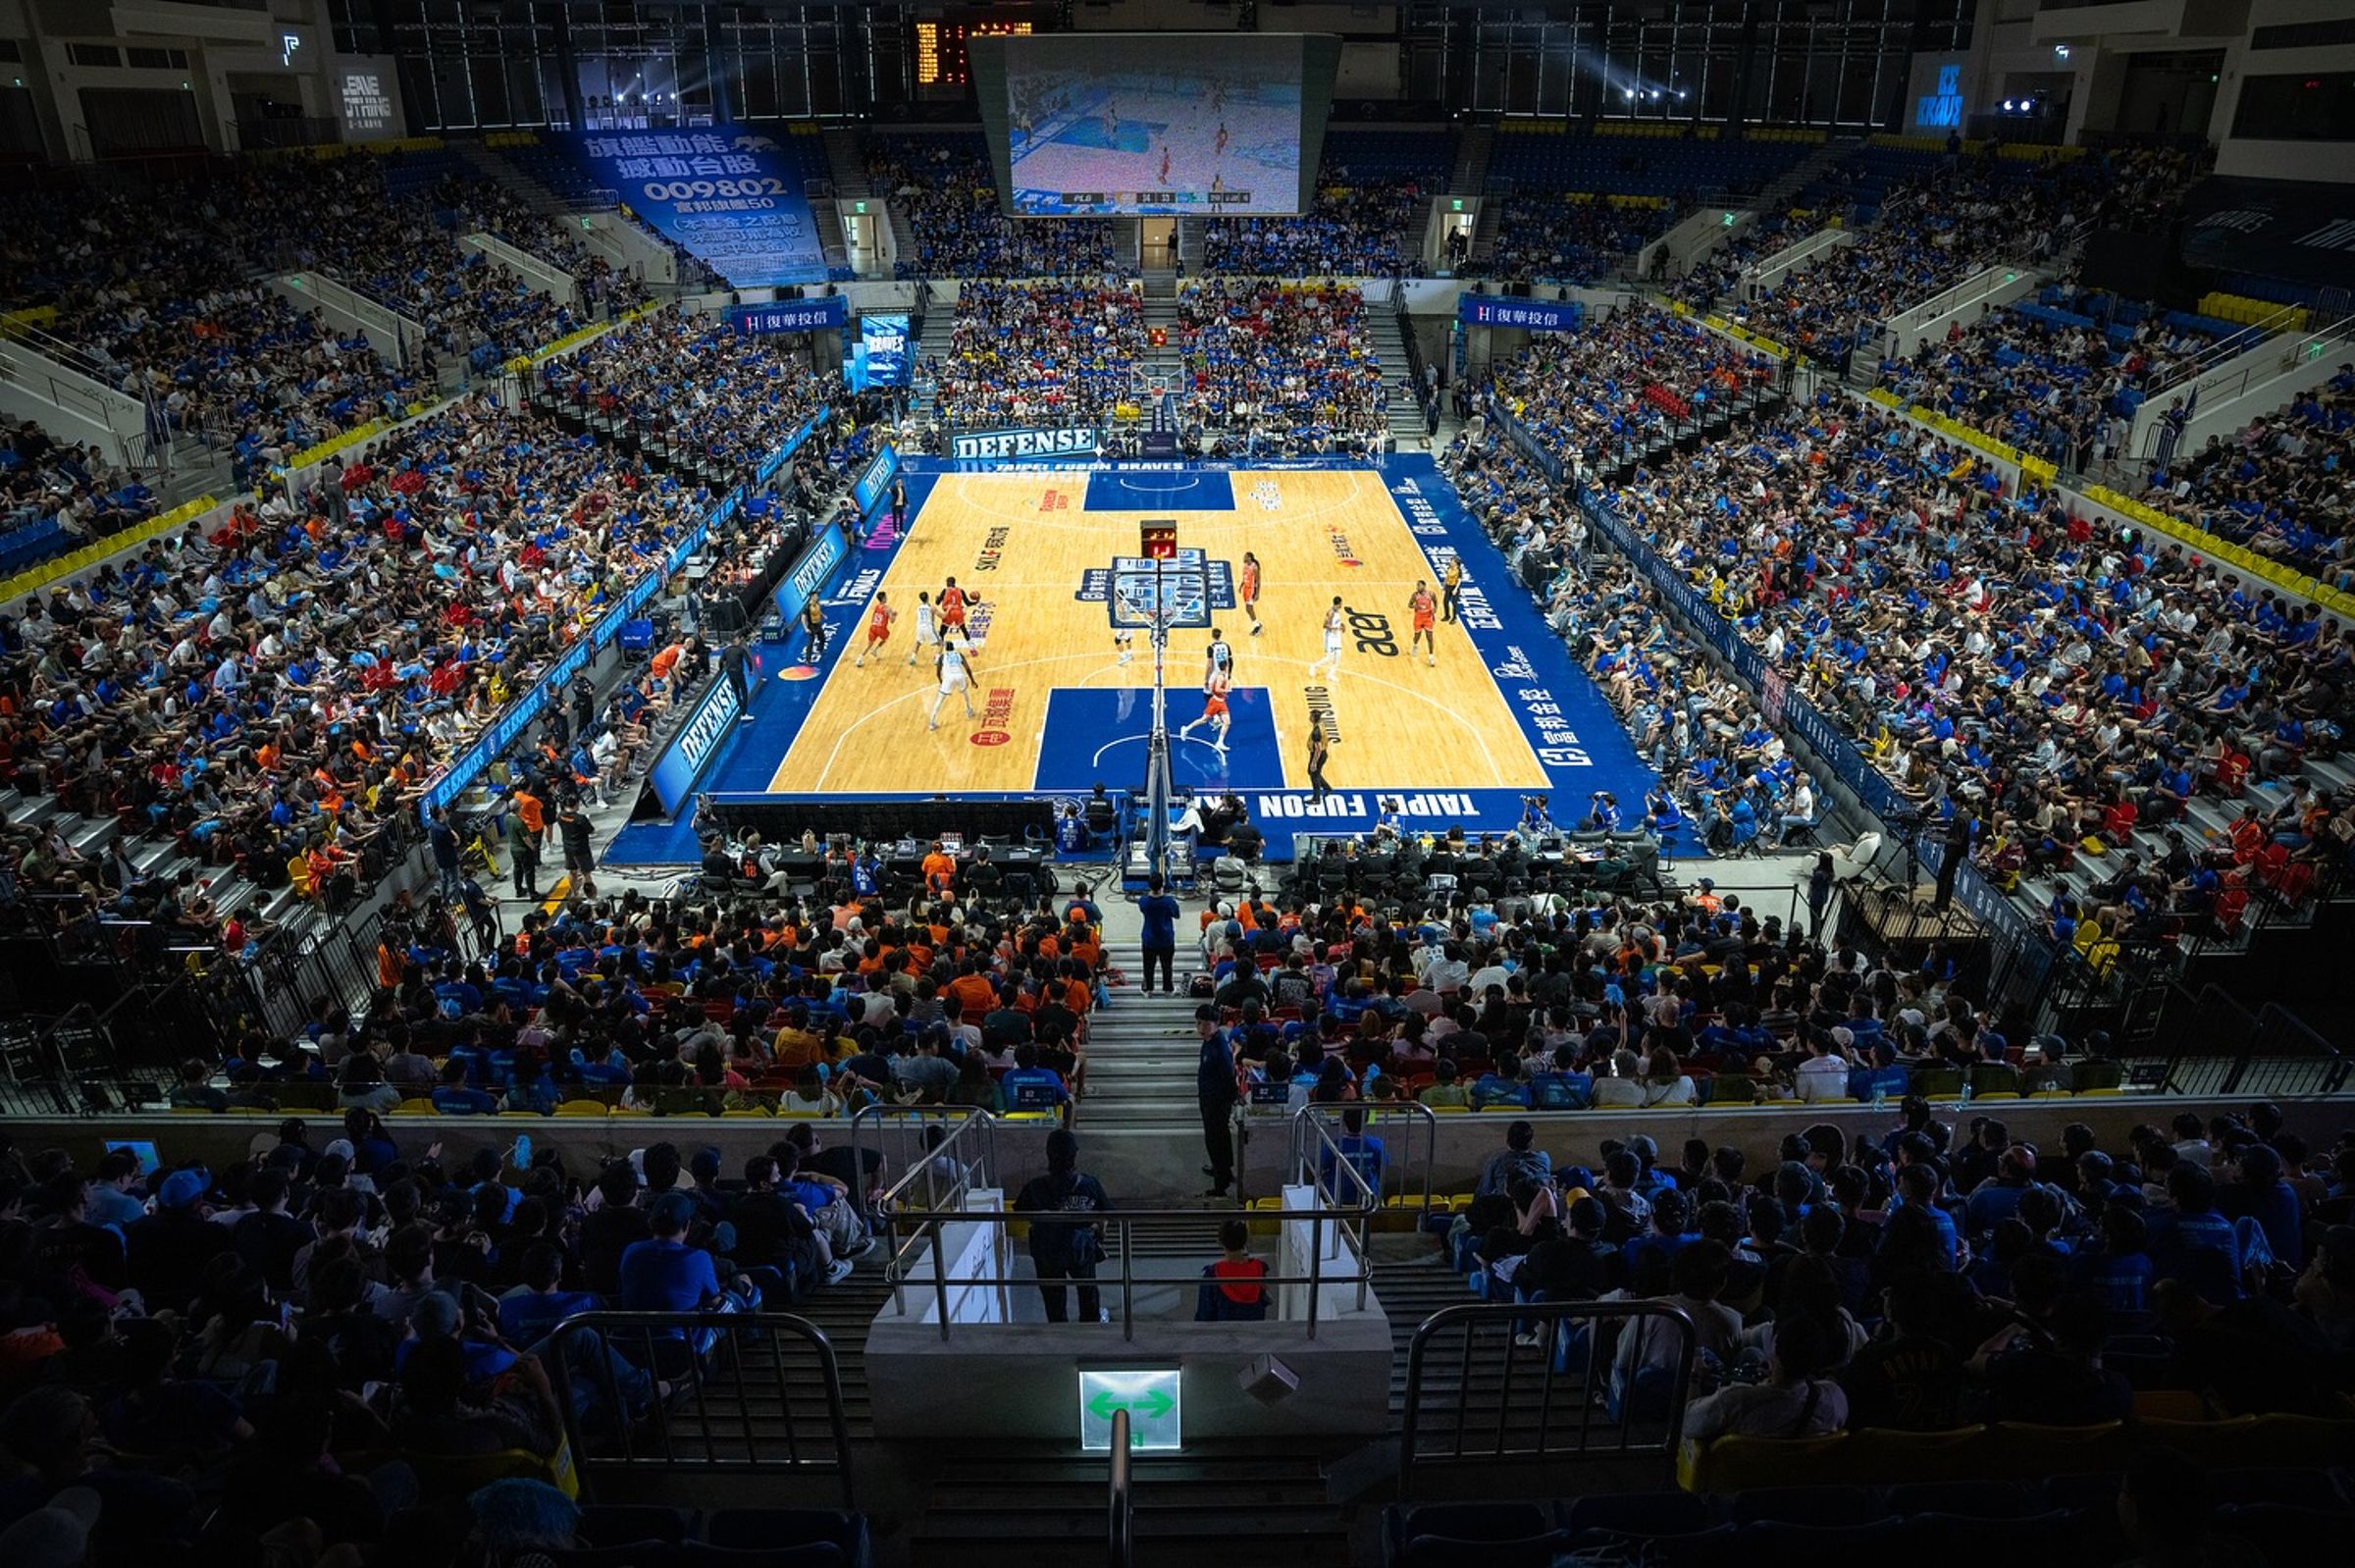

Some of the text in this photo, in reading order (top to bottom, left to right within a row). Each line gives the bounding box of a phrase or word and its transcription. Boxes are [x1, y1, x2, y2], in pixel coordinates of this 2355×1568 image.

[584, 133, 729, 157] 旗艦動能
[615, 154, 760, 179] 撼動台股
[644, 178, 787, 201] 009802
[766, 311, 828, 329] 復華投信
[1497, 308, 1558, 326] 復華投信
[958, 429, 1092, 458] DEFENSE
[996, 462, 1049, 471] TAIPEI
[1118, 462, 1184, 471] BRAVES
[792, 542, 834, 601] DEFENSE
[848, 568, 881, 601] FINALS
[1343, 606, 1399, 656] acer
[1694, 602, 1718, 636] BRAVES
[680, 678, 738, 769] DEFENSE
[1518, 689, 1580, 746] 富邦金控
[1806, 717, 1840, 760] BRAVES
[1259, 794, 1366, 817] FUBON
[1976, 889, 2025, 955] BRAVES
